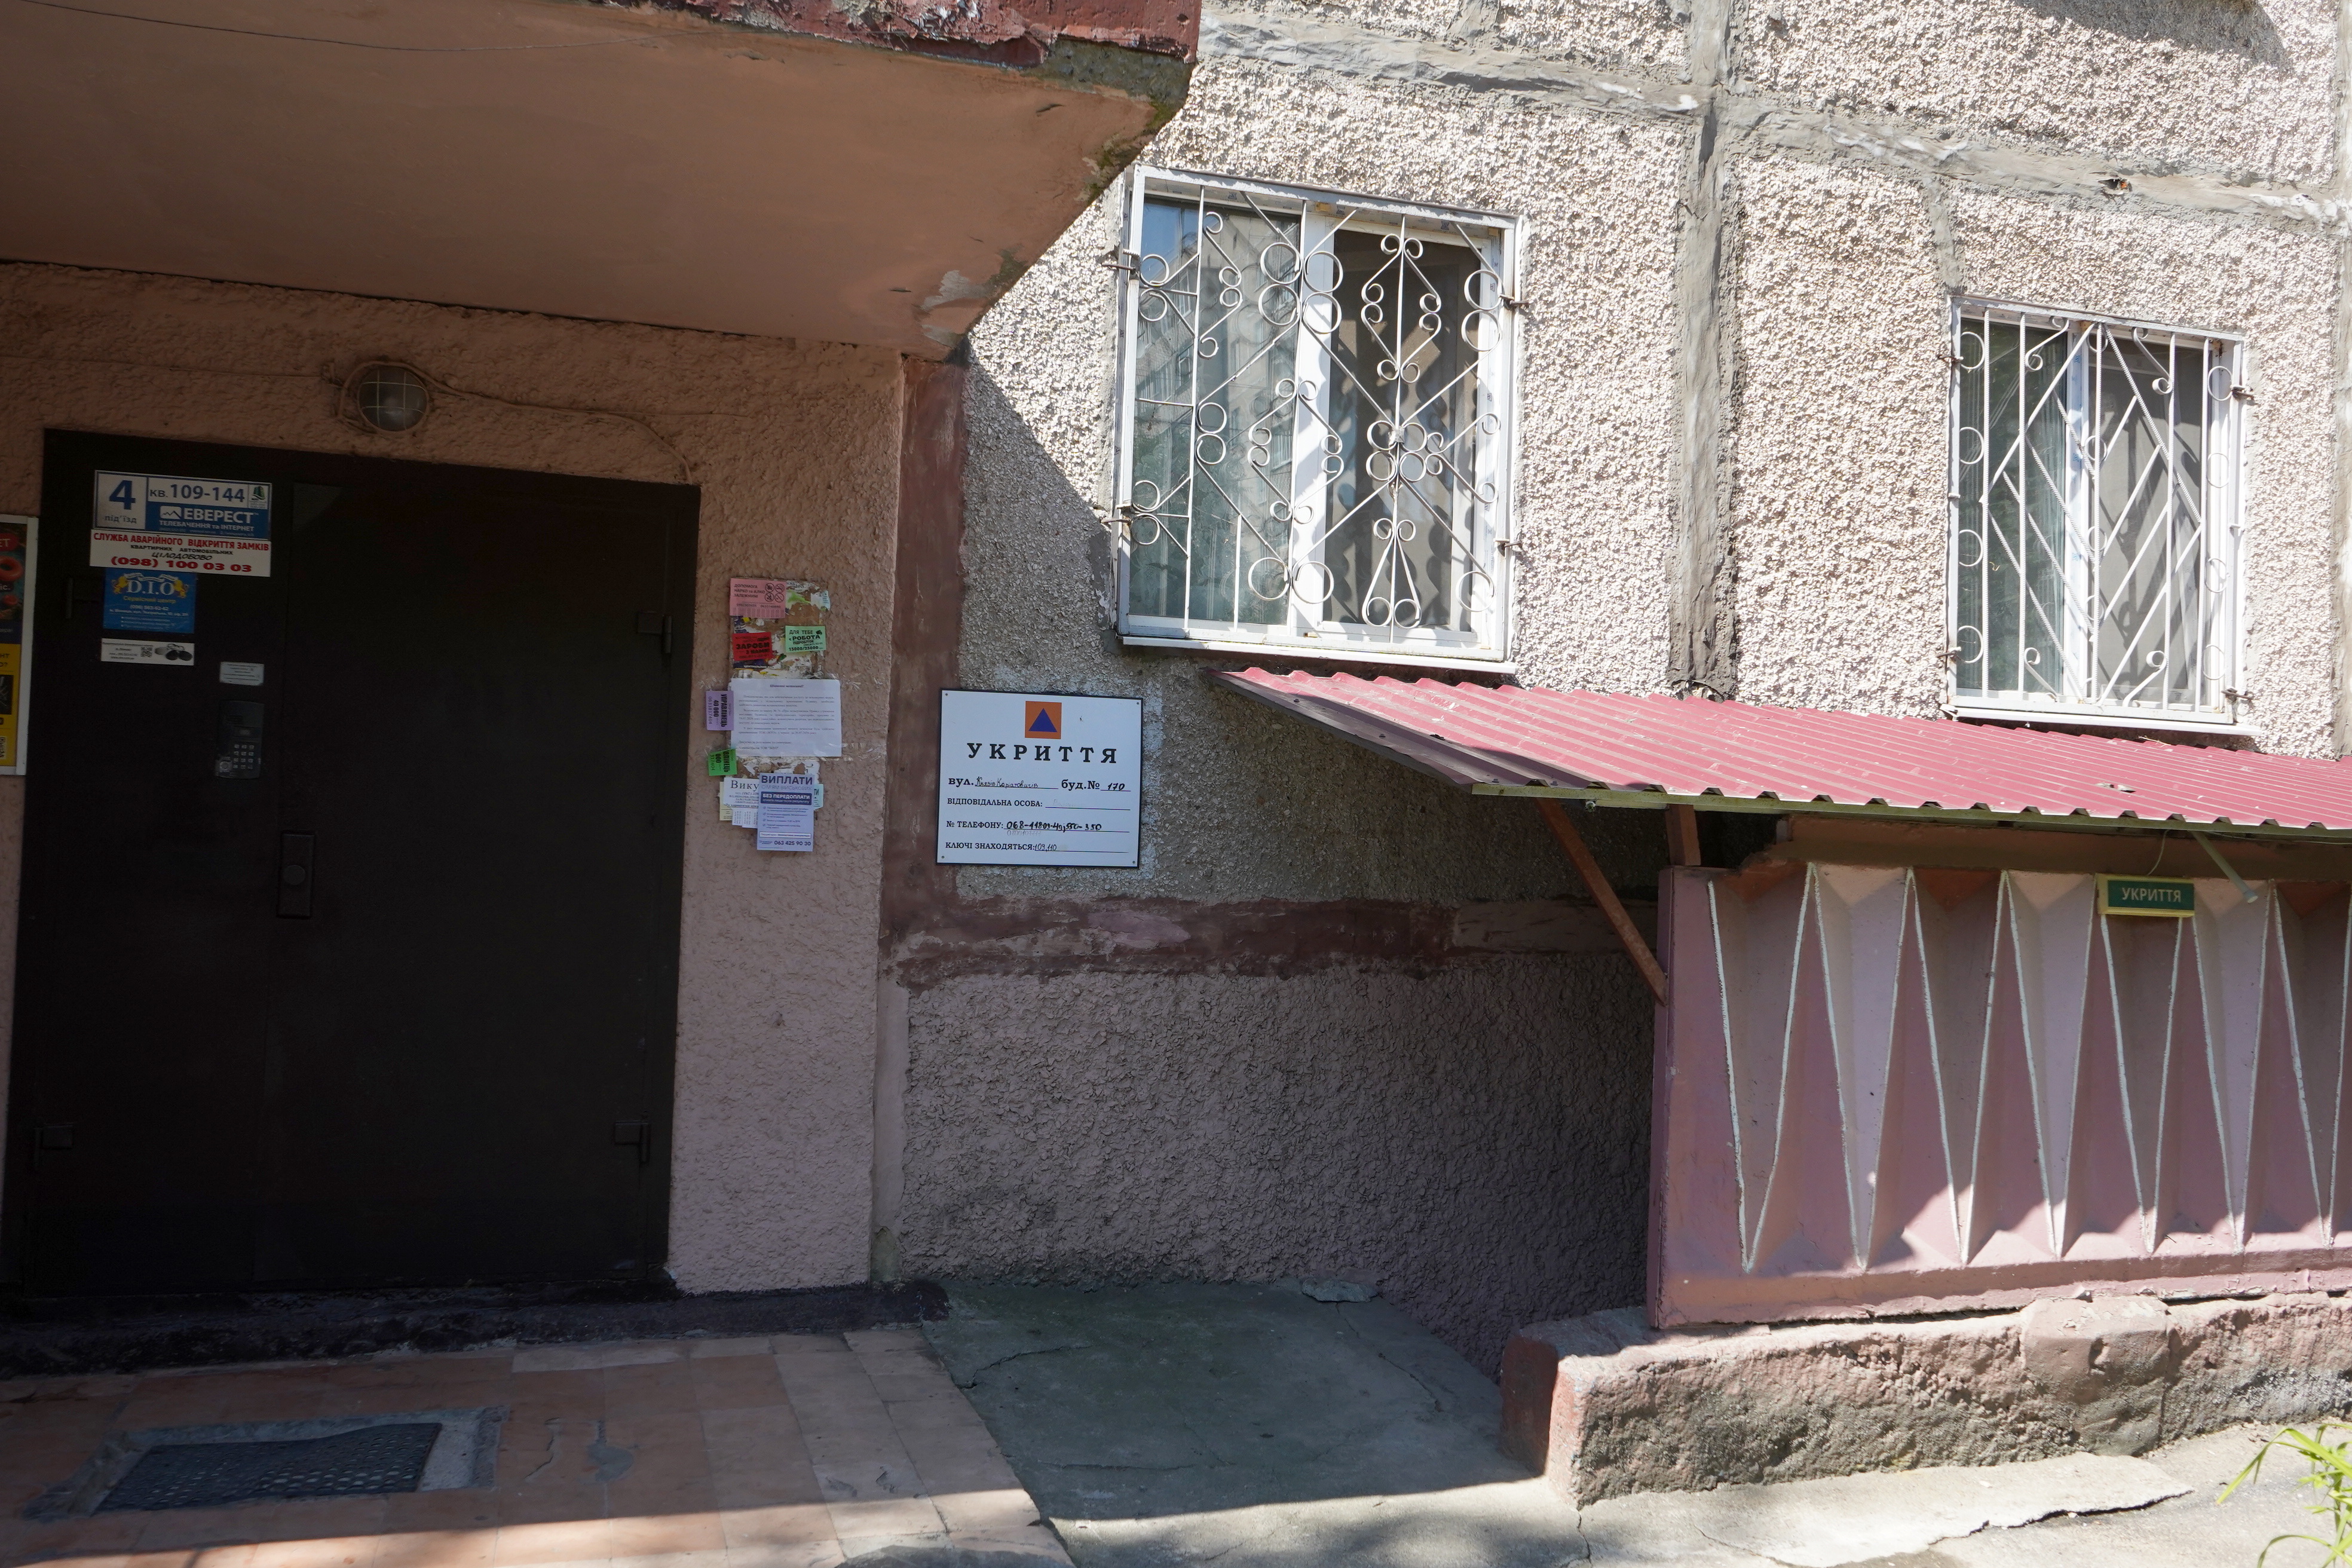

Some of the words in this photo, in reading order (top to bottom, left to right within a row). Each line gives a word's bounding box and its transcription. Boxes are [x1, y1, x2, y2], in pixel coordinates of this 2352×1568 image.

[109, 480, 136, 510] 4
[170, 484, 245, 503] 109-144
[105, 514, 137, 524] під'їзд
[183, 510, 253, 523] ЕВЕРЕСТ
[159, 520, 211, 529] ТЕЛЕБАЧЕННЯ
[94, 533, 128, 542] СЛУЖБА
[130, 535, 183, 546] АВАРІЙНОГО
[188, 539, 235, 549] ВІДКРИТТЯ
[237, 543, 269, 551] ЗАМКІВ
[111, 556, 158, 568] (098)
[166, 561, 198, 569] 100
[230, 564, 252, 572] 03
[152, 552, 213, 561] ЦІЛОДОБОВО
[127, 580, 174, 596] D.I.O
[966, 742, 1117, 764] УКРИТТЯ
[761, 775, 813, 785] ВИПЛАТИ
[948, 777, 974, 788] вул.
[1107, 782, 1126, 792] 170
[947, 798, 1012, 806] ВІДПОВІДАЛЬНА
[975, 843, 1034, 852] ЗНАХОДЯТЬСЯ:
[2121, 887, 2181, 903] УКРИТТЯ
